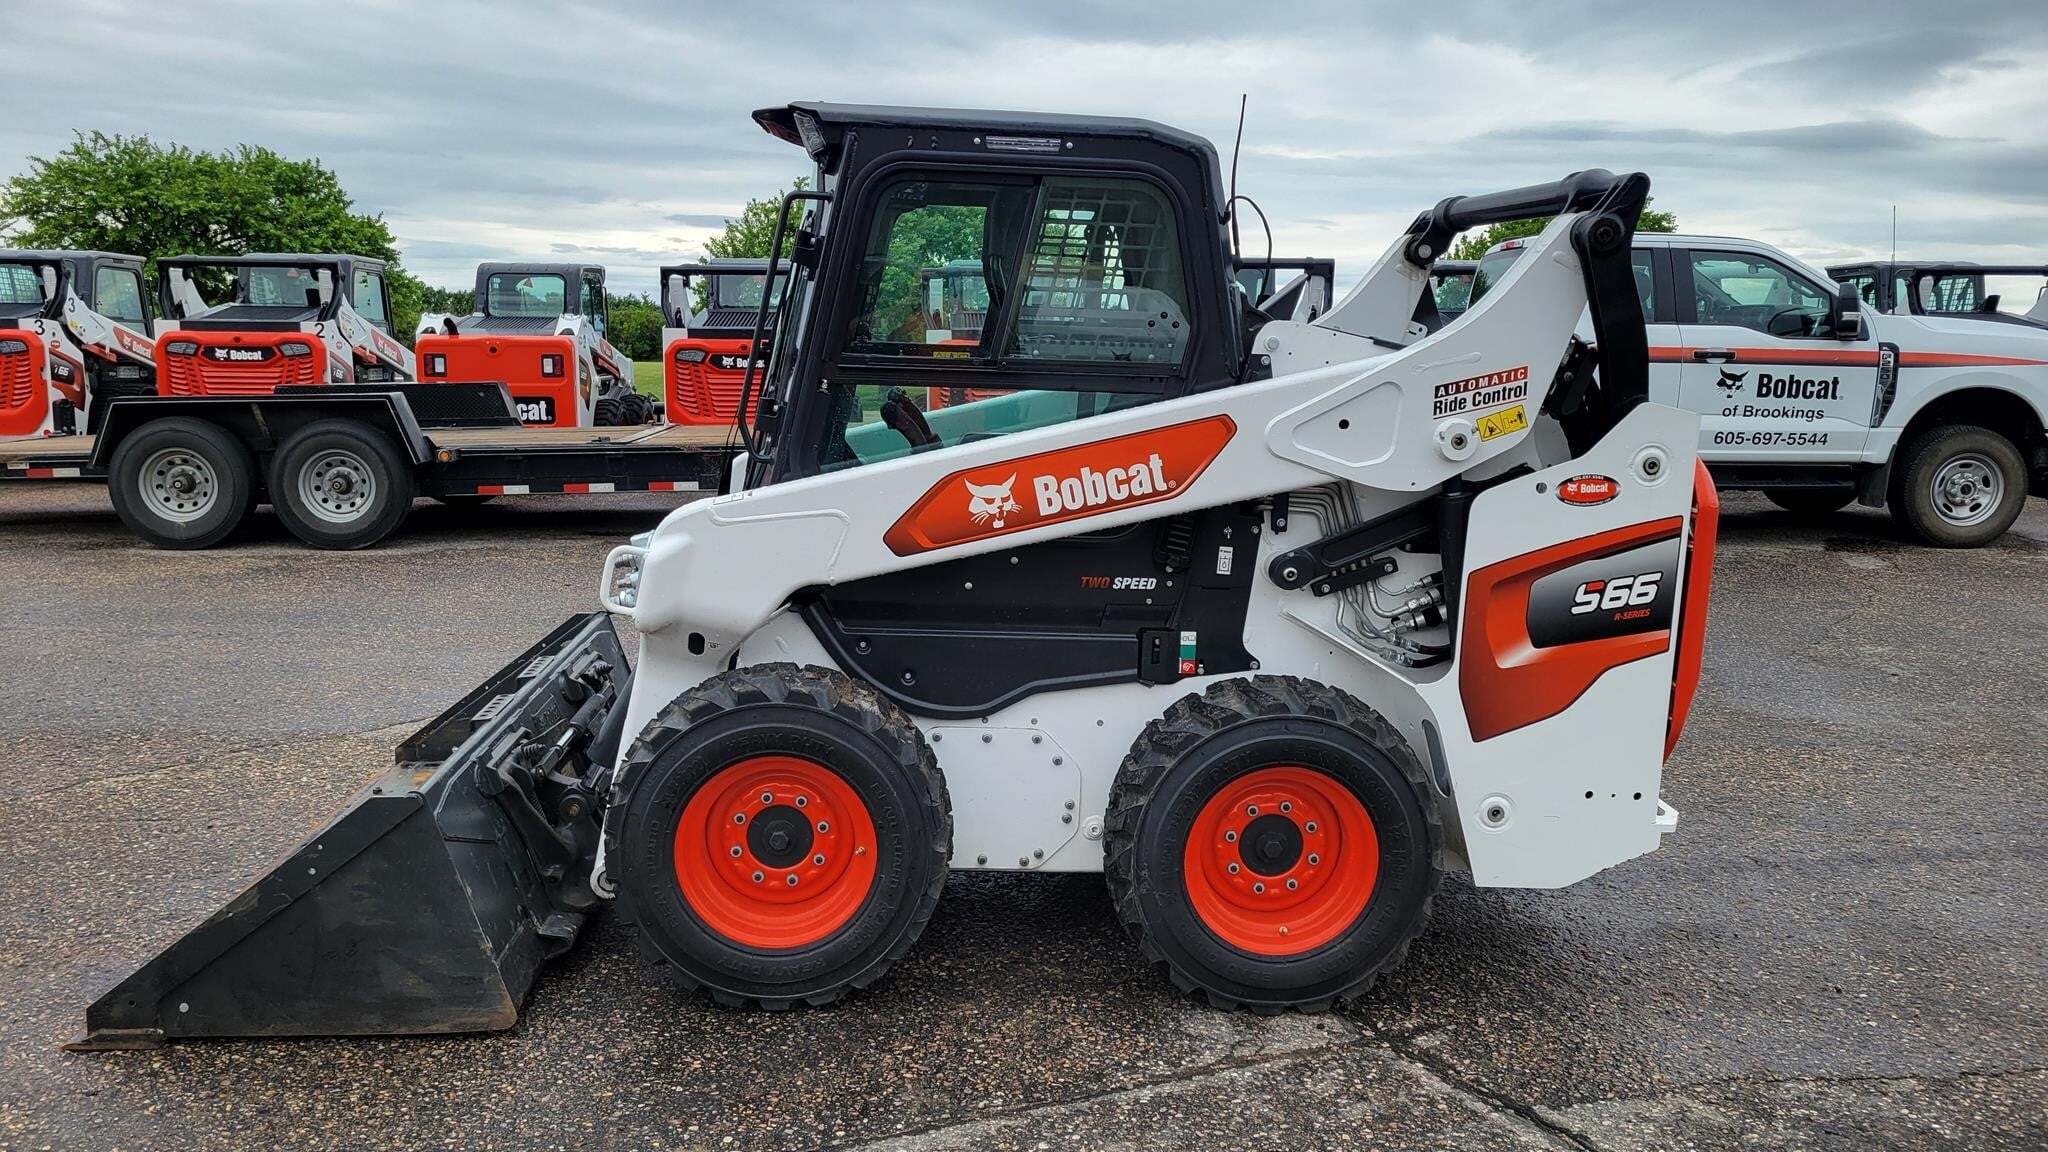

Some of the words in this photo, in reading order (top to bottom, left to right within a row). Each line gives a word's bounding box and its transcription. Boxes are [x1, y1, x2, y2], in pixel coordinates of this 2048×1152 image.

[67, 297, 76, 313] 3
[34, 319, 45, 335] 3
[314, 322, 326, 338] 2
[230, 350, 262, 360] Bobcat
[1438, 369, 1525, 397] AUTOMATIC
[1756, 373, 1840, 400] Bobcat
[1433, 396, 1467, 416] Ride
[1472, 381, 1528, 407] Control
[1722, 405, 1739, 417] of
[1742, 405, 1825, 422] Brookings
[1714, 431, 1828, 445] 605-697-5544
[1033, 453, 1168, 517] Bobcat
[1580, 482, 1609, 494] Bobcat
[1080, 576, 1110, 588] TWO
[1112, 577, 1157, 590] SPEED
[1570, 572, 1663, 615] S66
[1614, 608, 1651, 621] R-SERIES
